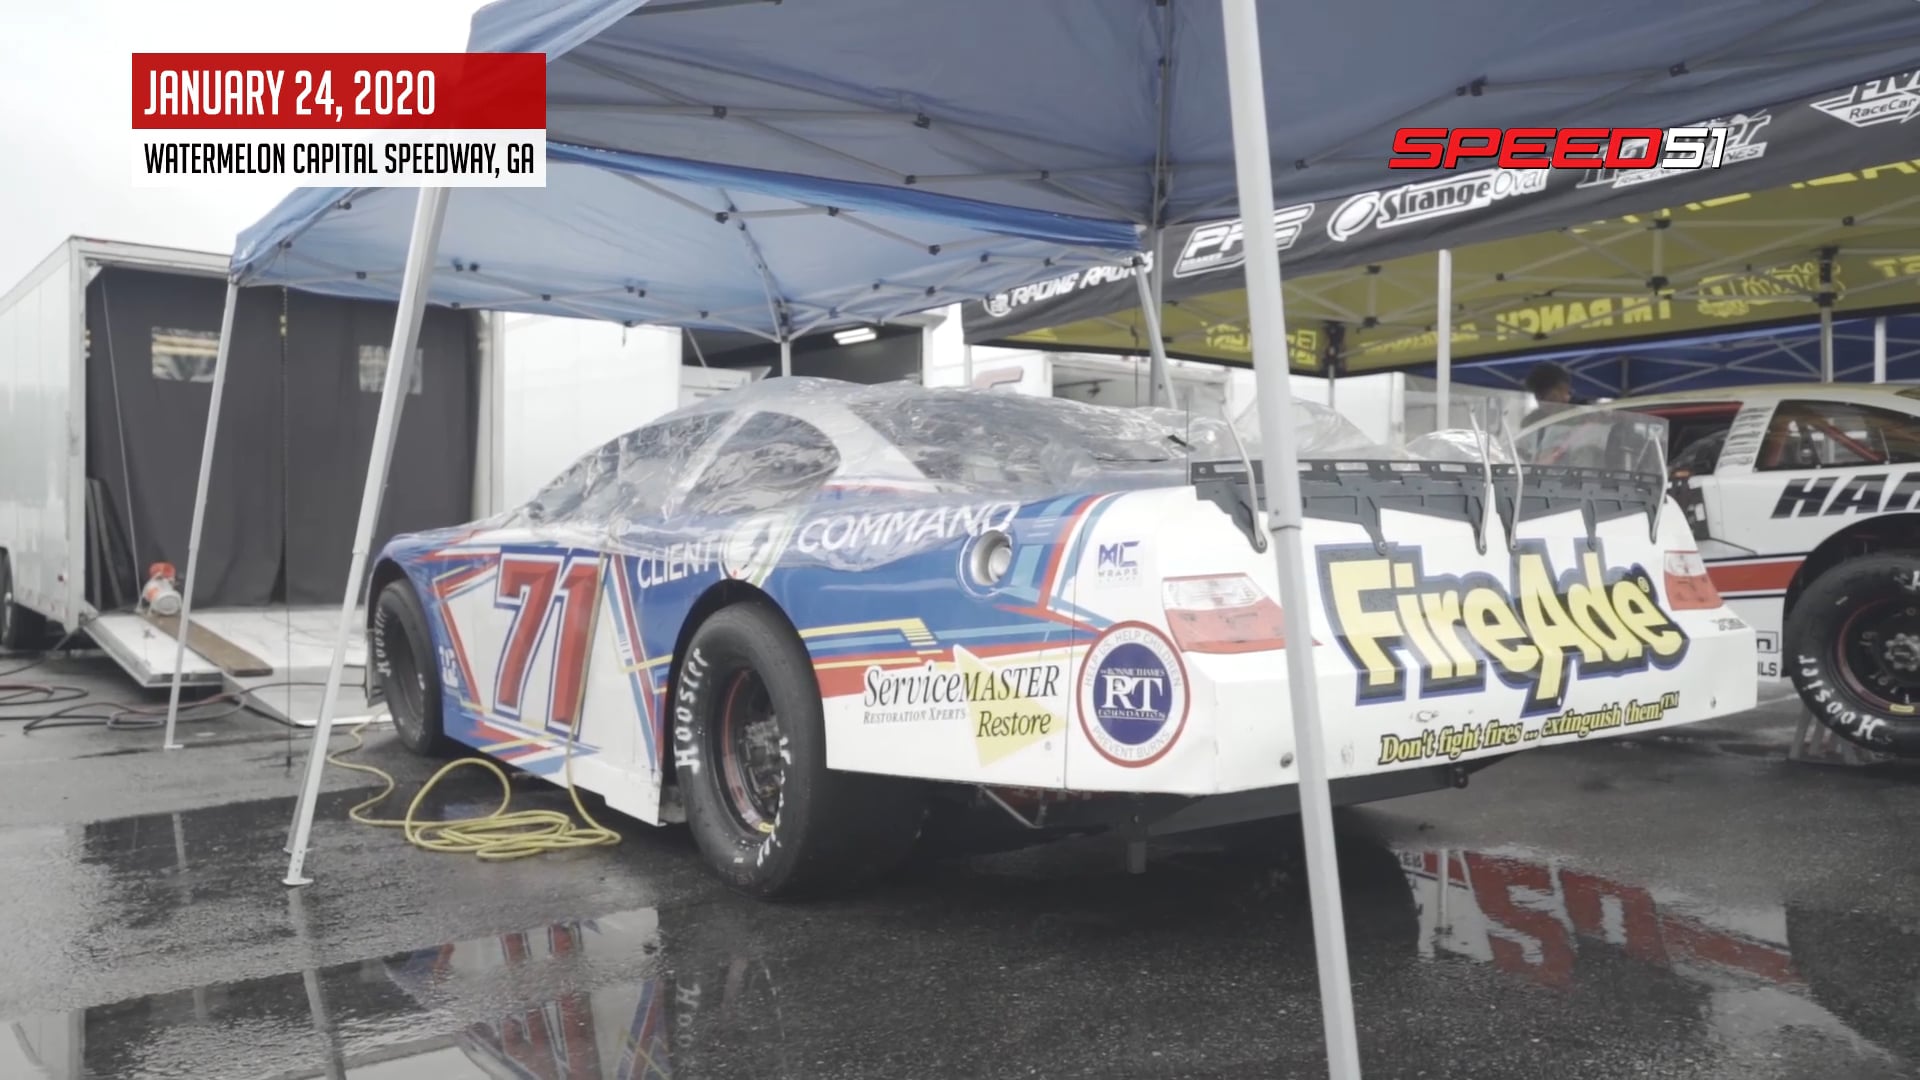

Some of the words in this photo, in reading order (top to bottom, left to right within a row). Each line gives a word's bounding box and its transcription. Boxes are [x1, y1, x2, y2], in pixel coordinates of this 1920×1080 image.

[1849, 98, 1916, 120] RaceCar
[1011, 272, 1079, 306] RACING
[637, 539, 714, 588] CLIENT
[798, 501, 1021, 553] COMMAND
[494, 548, 607, 740] 71
[1115, 630, 1141, 643] HELP
[1143, 634, 1182, 687] CHILDREN
[673, 648, 709, 774] Hoosier
[864, 665, 1060, 708] ServiceMASTER
[1101, 674, 1163, 712] RT
[1798, 654, 1888, 741] Hoosier
[977, 710, 1052, 738] Restore
[1093, 725, 1133, 759] PREVENT
[1379, 731, 1436, 766] Don't
[1437, 724, 1482, 759] fight
[1482, 719, 1523, 749] fires
[1542, 702, 1622, 740] extinguish
